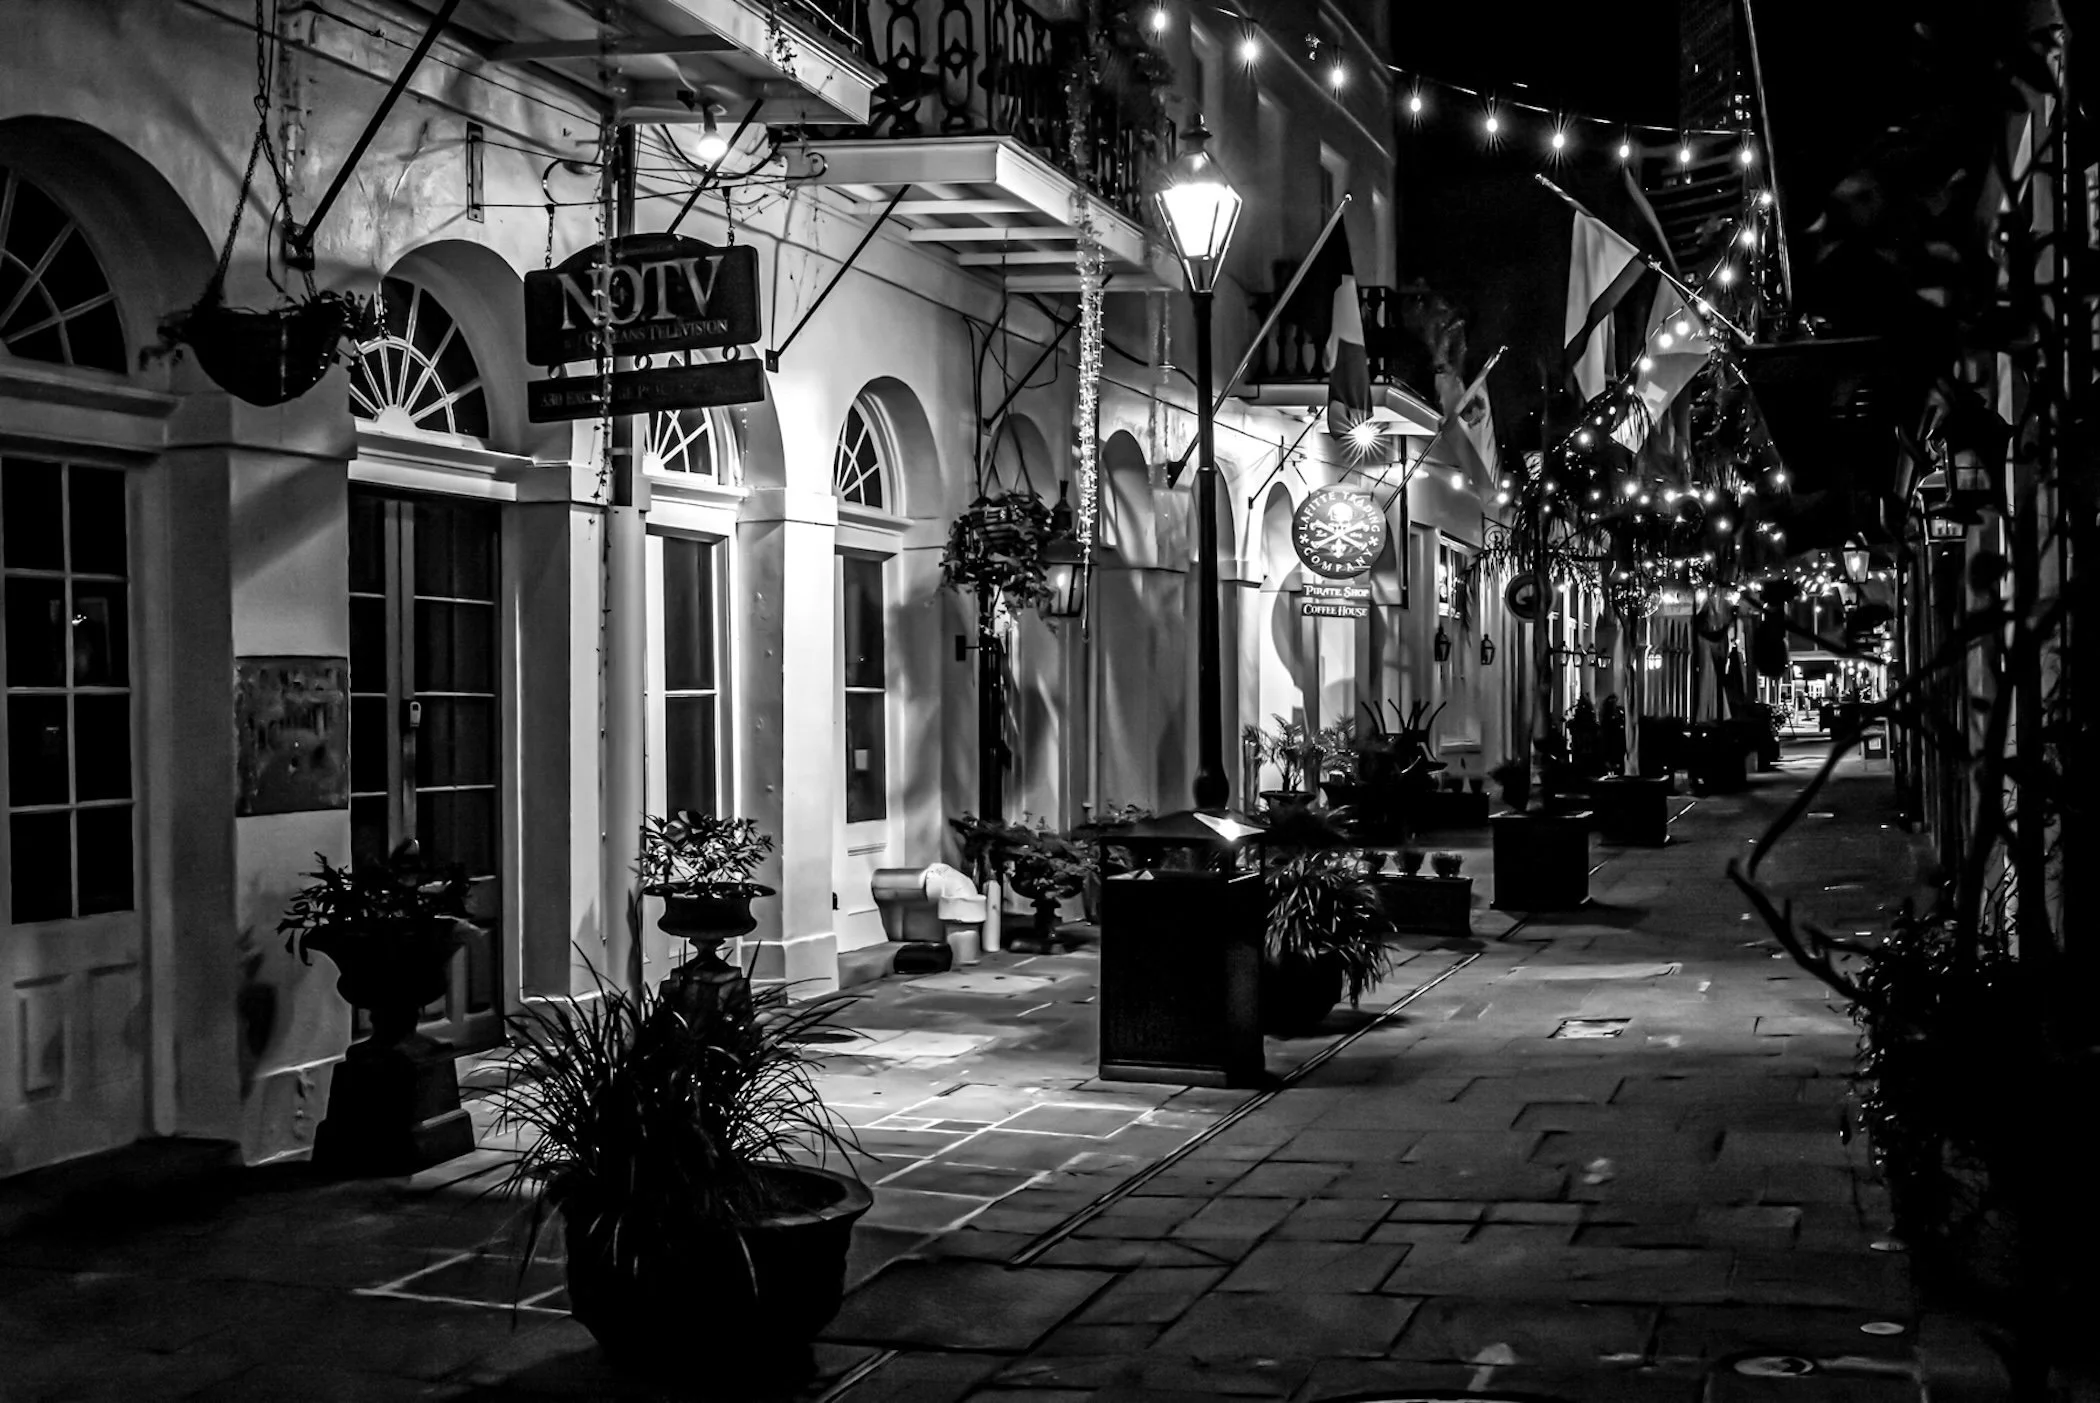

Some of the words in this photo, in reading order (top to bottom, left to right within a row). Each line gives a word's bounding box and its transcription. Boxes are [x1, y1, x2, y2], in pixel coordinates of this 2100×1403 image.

[557, 254, 725, 331] NOTV
[646, 319, 729, 342] TELEVISION
[1299, 491, 1336, 531] LAFITTE
[1342, 490, 1380, 532] TRADING
[1303, 547, 1373, 572] COMPANY
[1303, 585, 1342, 596] PIRATE
[1343, 586, 1370, 598] SHOP
[1303, 603, 1337, 614] COFFEE
[1338, 605, 1368, 617] HOUSE
